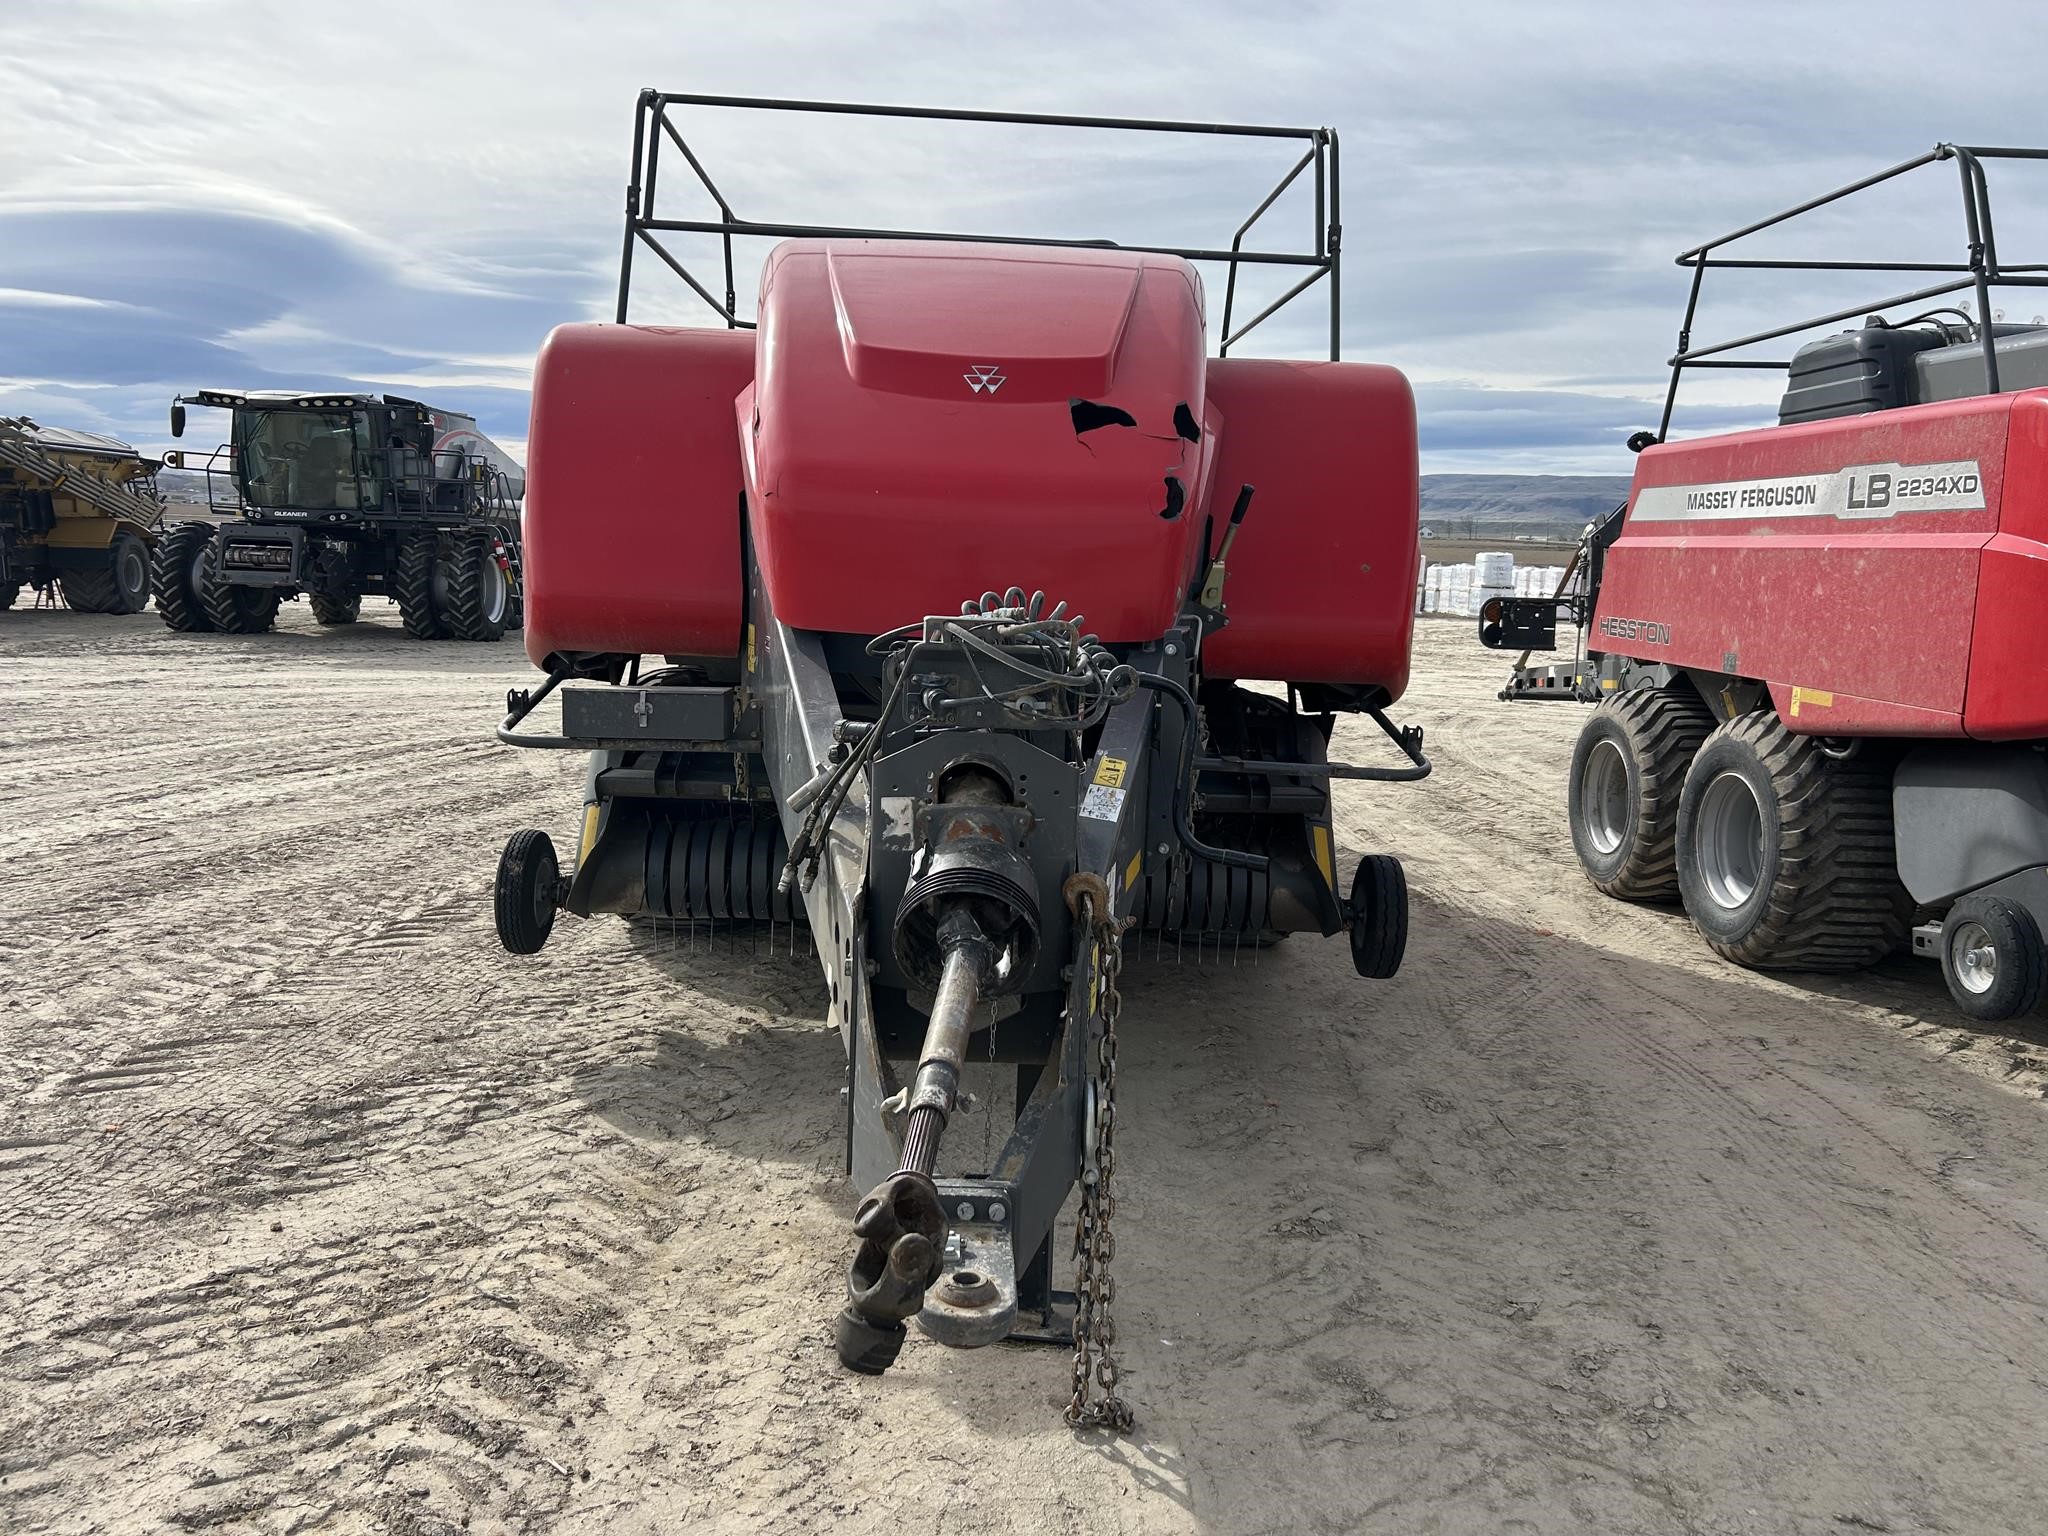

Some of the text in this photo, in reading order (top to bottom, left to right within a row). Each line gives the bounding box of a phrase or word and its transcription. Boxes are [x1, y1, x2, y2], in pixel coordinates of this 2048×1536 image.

[1687, 473, 1979, 511] MASSEY FERGUSON LB 2234XD
[1599, 616, 1671, 645] HESSTON
